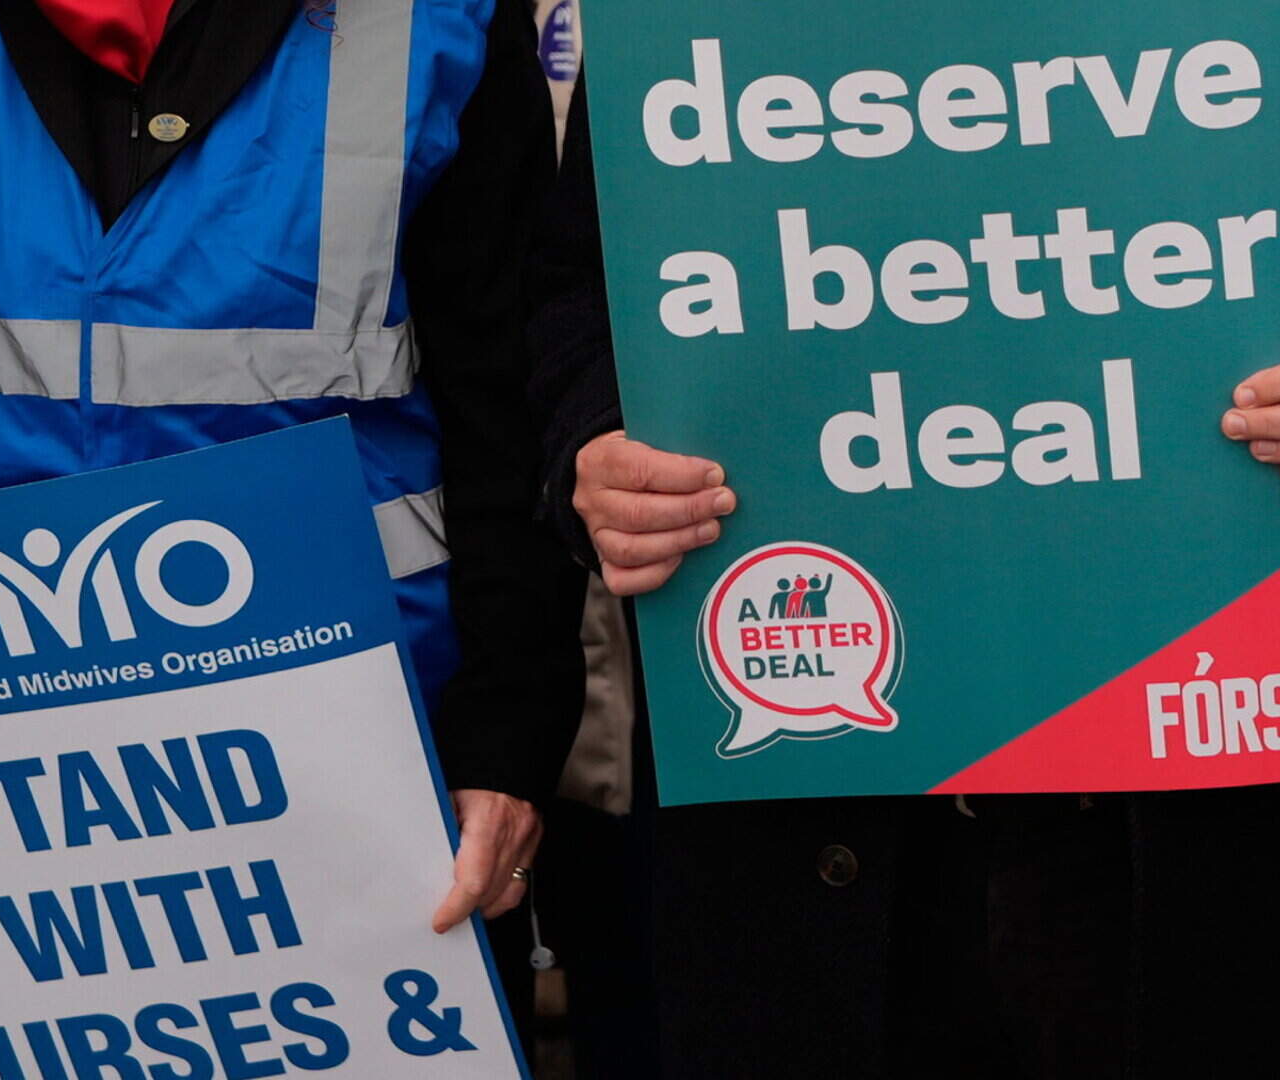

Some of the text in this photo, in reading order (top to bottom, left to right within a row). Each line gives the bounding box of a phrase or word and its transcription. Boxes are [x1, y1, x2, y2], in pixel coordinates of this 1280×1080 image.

[642, 37, 1263, 167] deserve
[658, 207, 1277, 339] a better
[819, 357, 1142, 495] deal
[738, 598, 762, 622] A
[740, 622, 874, 652] BETTER
[17, 656, 155, 697] Midwives
[160, 620, 355, 676] Organisation
[743, 653, 835, 681] DEAL
[383, 968, 478, 1057] &
